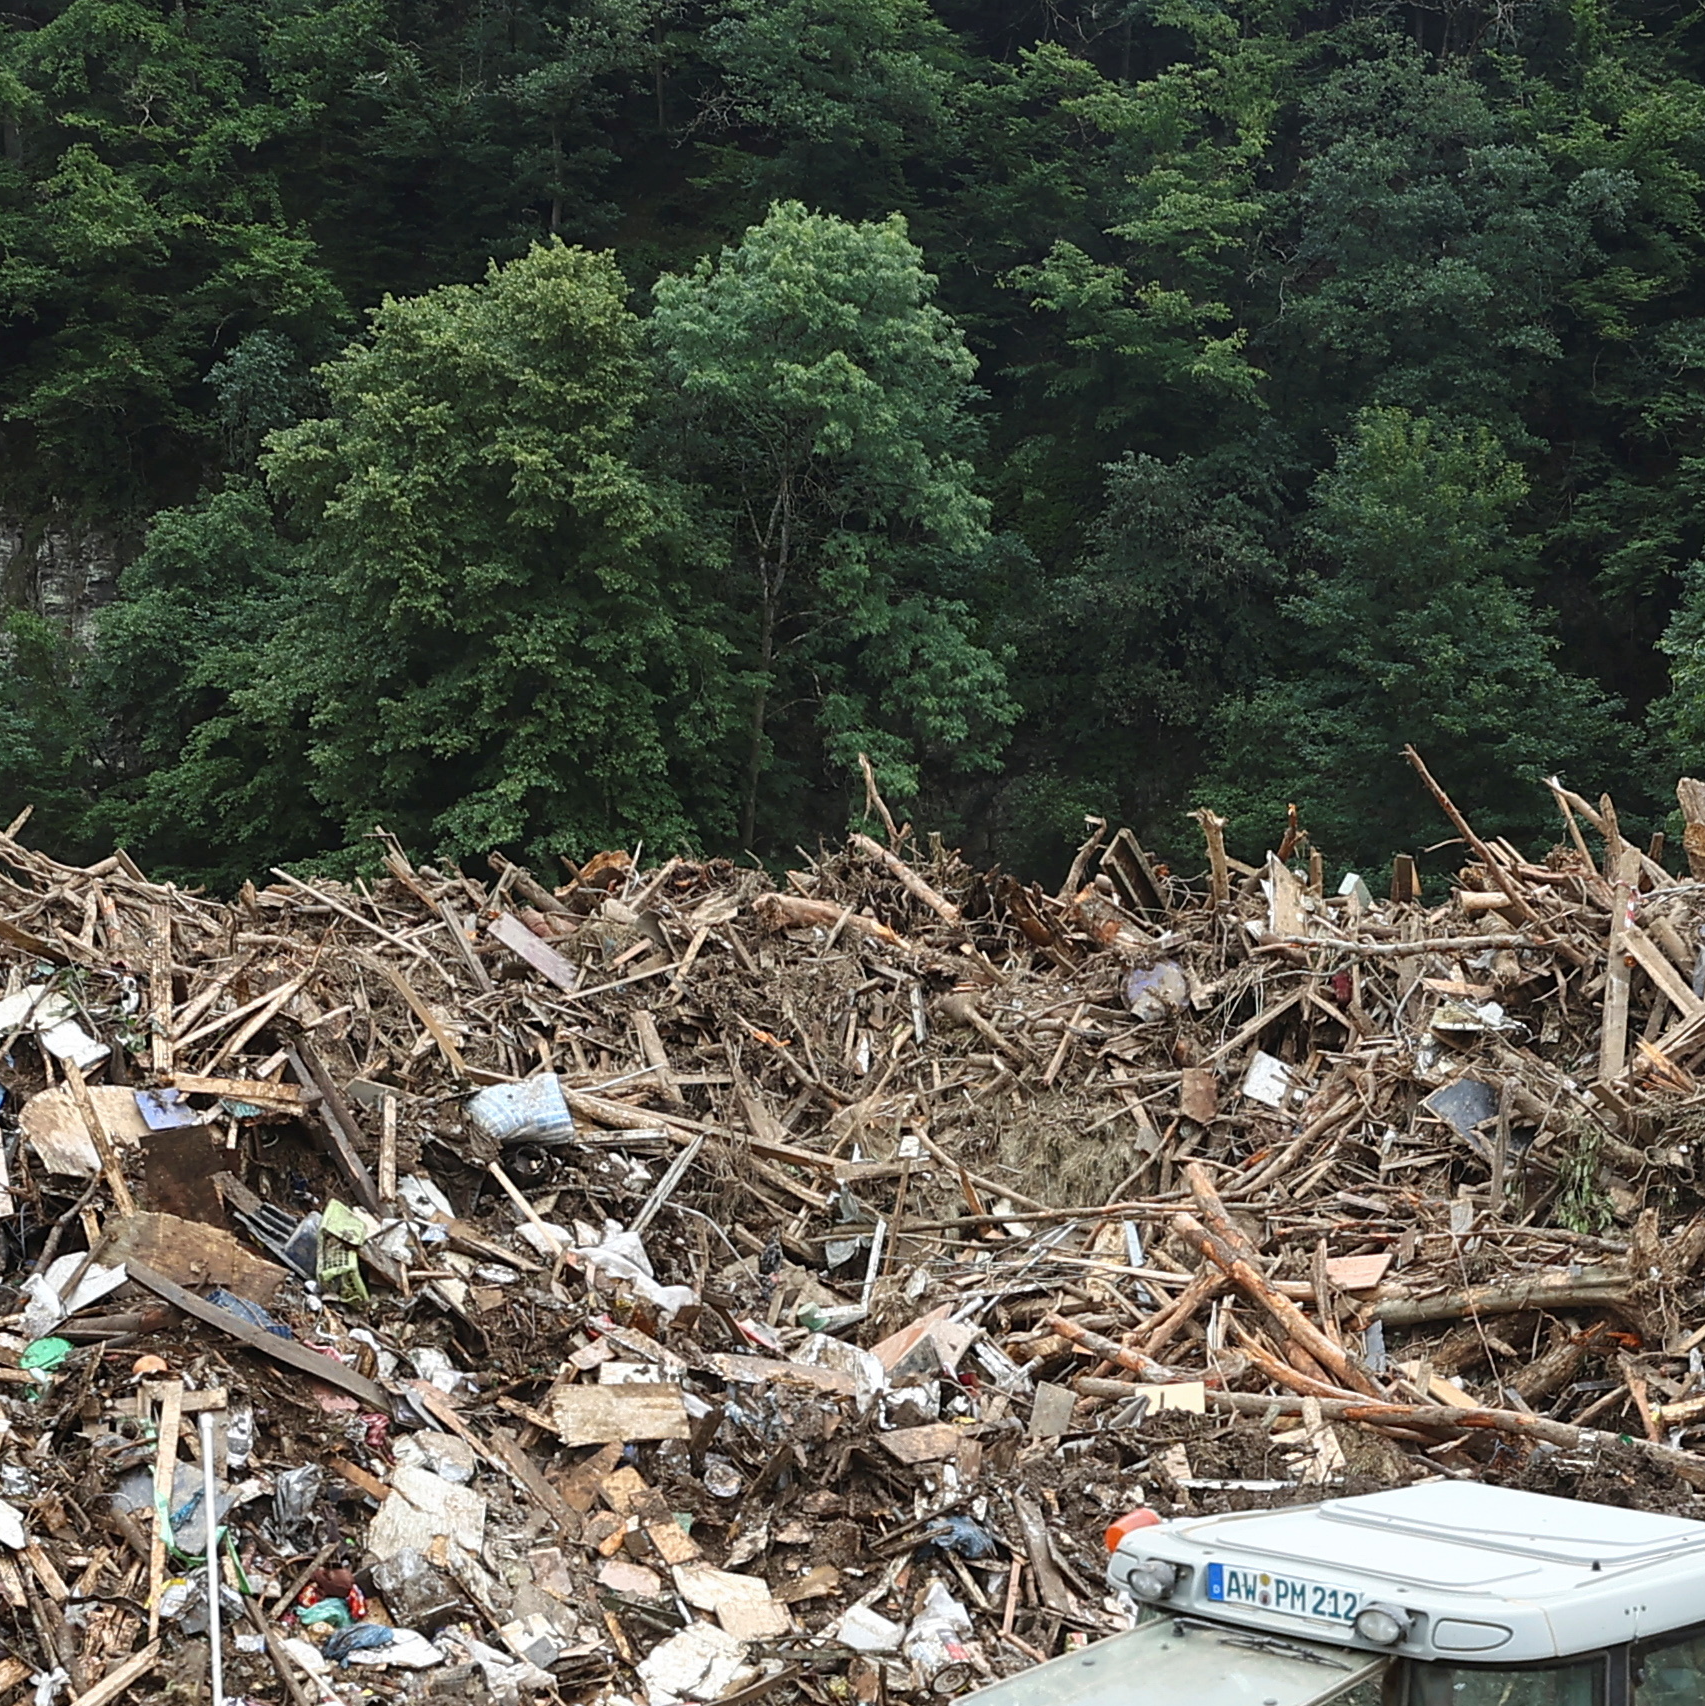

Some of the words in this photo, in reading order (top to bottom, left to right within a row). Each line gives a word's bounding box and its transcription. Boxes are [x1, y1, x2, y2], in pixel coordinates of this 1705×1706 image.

[1227, 1571, 1257, 1602] AW
[1274, 1578, 1306, 1612] PM
[1312, 1585, 1357, 1621] 212
